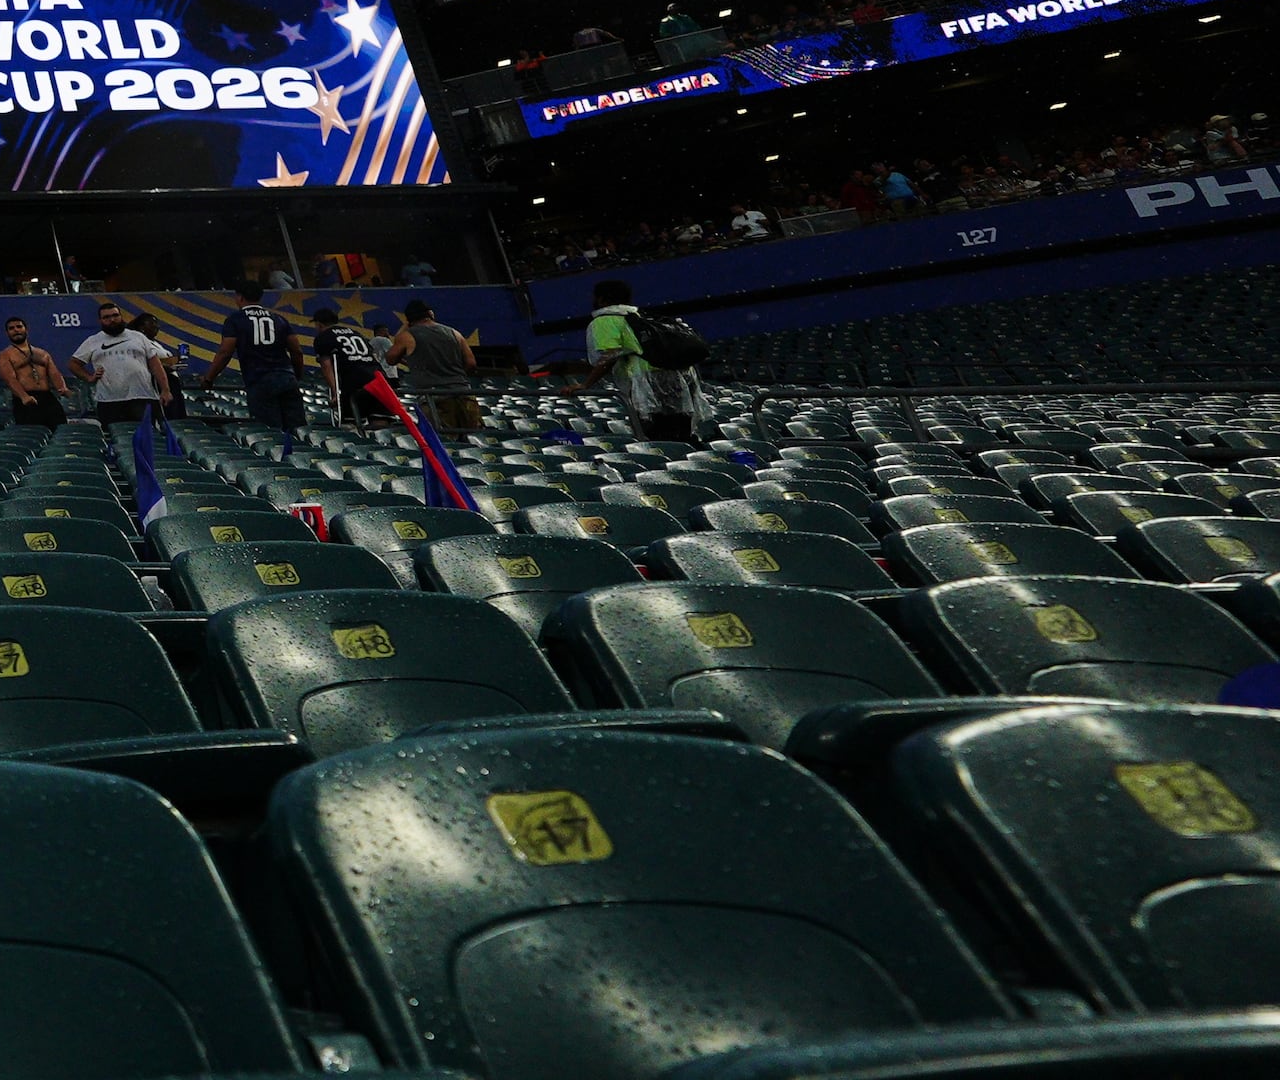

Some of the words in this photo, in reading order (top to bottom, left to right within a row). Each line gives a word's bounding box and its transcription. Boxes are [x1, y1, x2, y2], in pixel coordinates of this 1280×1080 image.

[940, 13, 1008, 38] FIFA
[105, 67, 320, 111] 2026
[543, 72, 720, 120] PHILADELPHIA
[957, 227, 998, 247] 127
[52, 312, 81, 327] 128
[249, 315, 276, 346] 10
[336, 336, 369, 356] 30
[274, 569, 297, 583] 19
[511, 563, 538, 576] 20
[22, 582, 46, 596] 18
[355, 635, 391, 655] 18
[541, 816, 591, 854] 17
